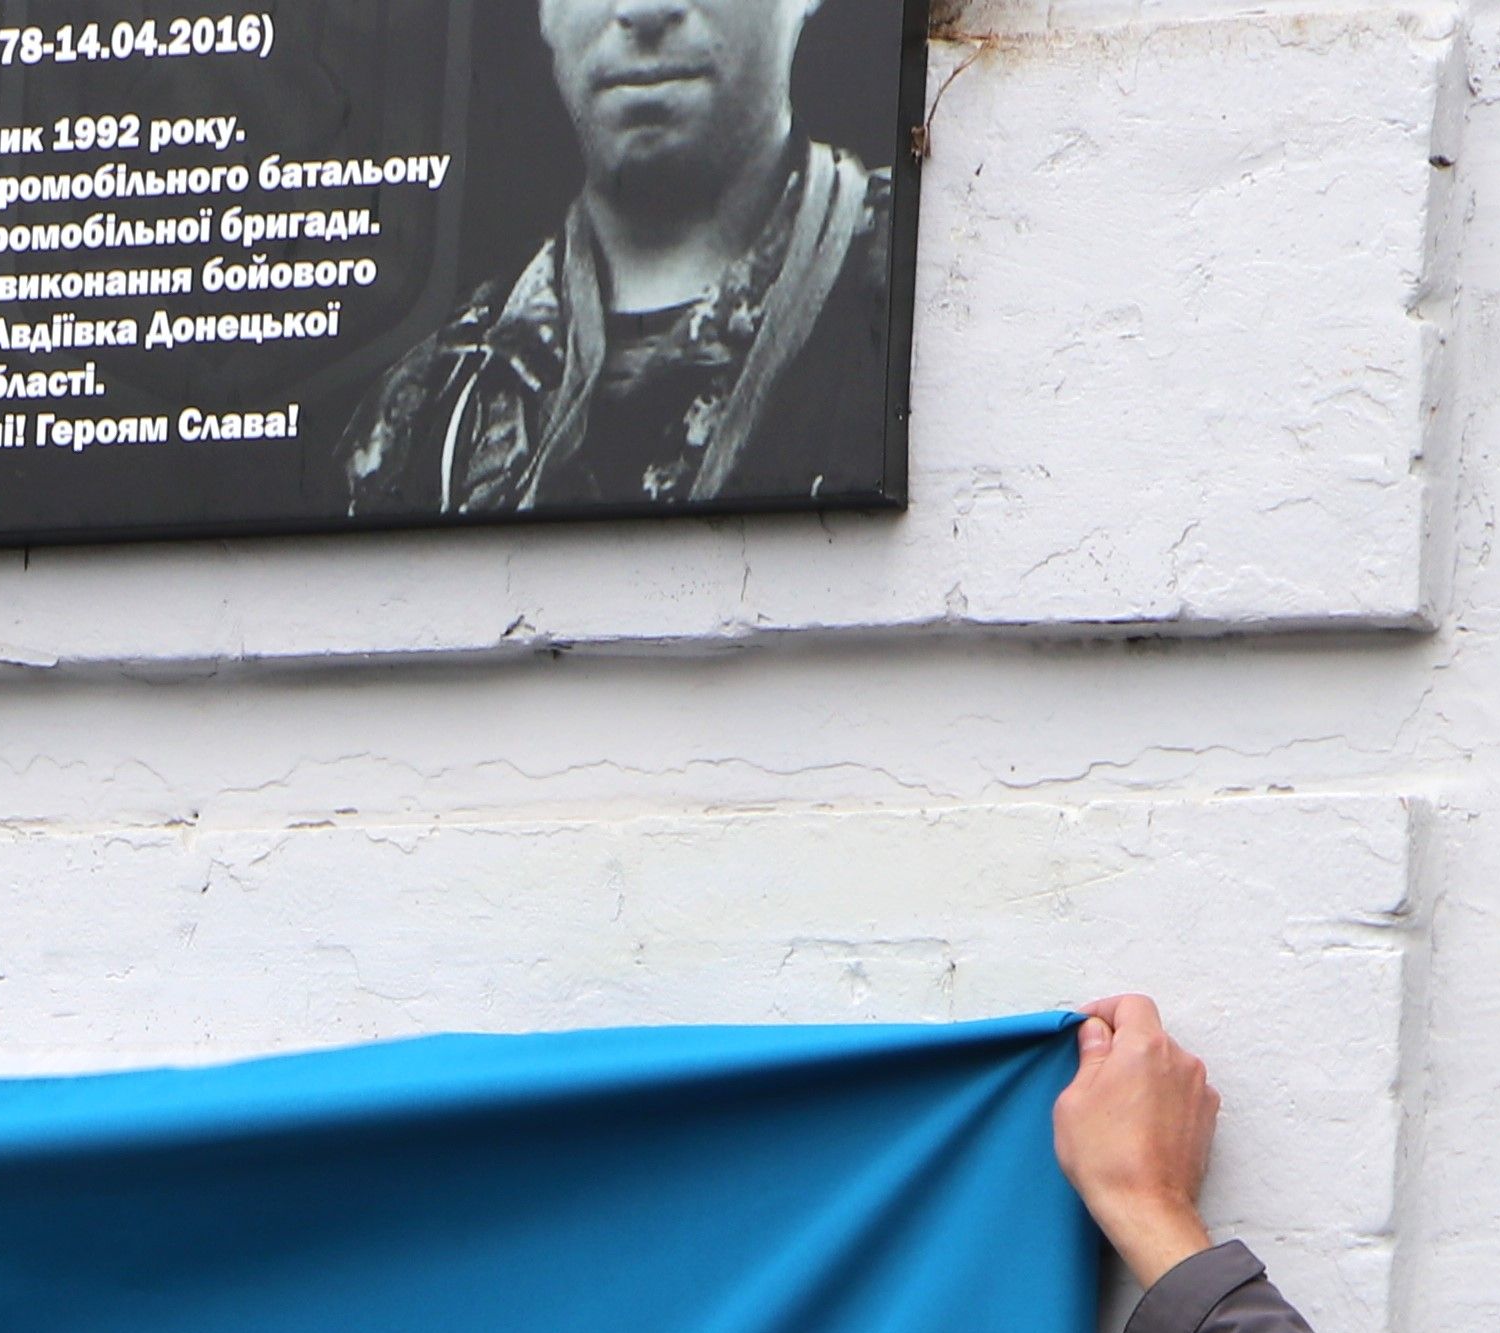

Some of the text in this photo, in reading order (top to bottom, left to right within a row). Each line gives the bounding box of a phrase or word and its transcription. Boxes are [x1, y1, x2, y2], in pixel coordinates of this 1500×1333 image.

[52, 114, 140, 151] 1992
[149, 116, 245, 153] року.
[258, 154, 451, 190] батальону
[220, 206, 380, 247] бригади.
[202, 253, 377, 292] бойового
[144, 301, 341, 350] Донецької
[36, 413, 168, 452] Героям
[178, 404, 299, 441] Слава!
